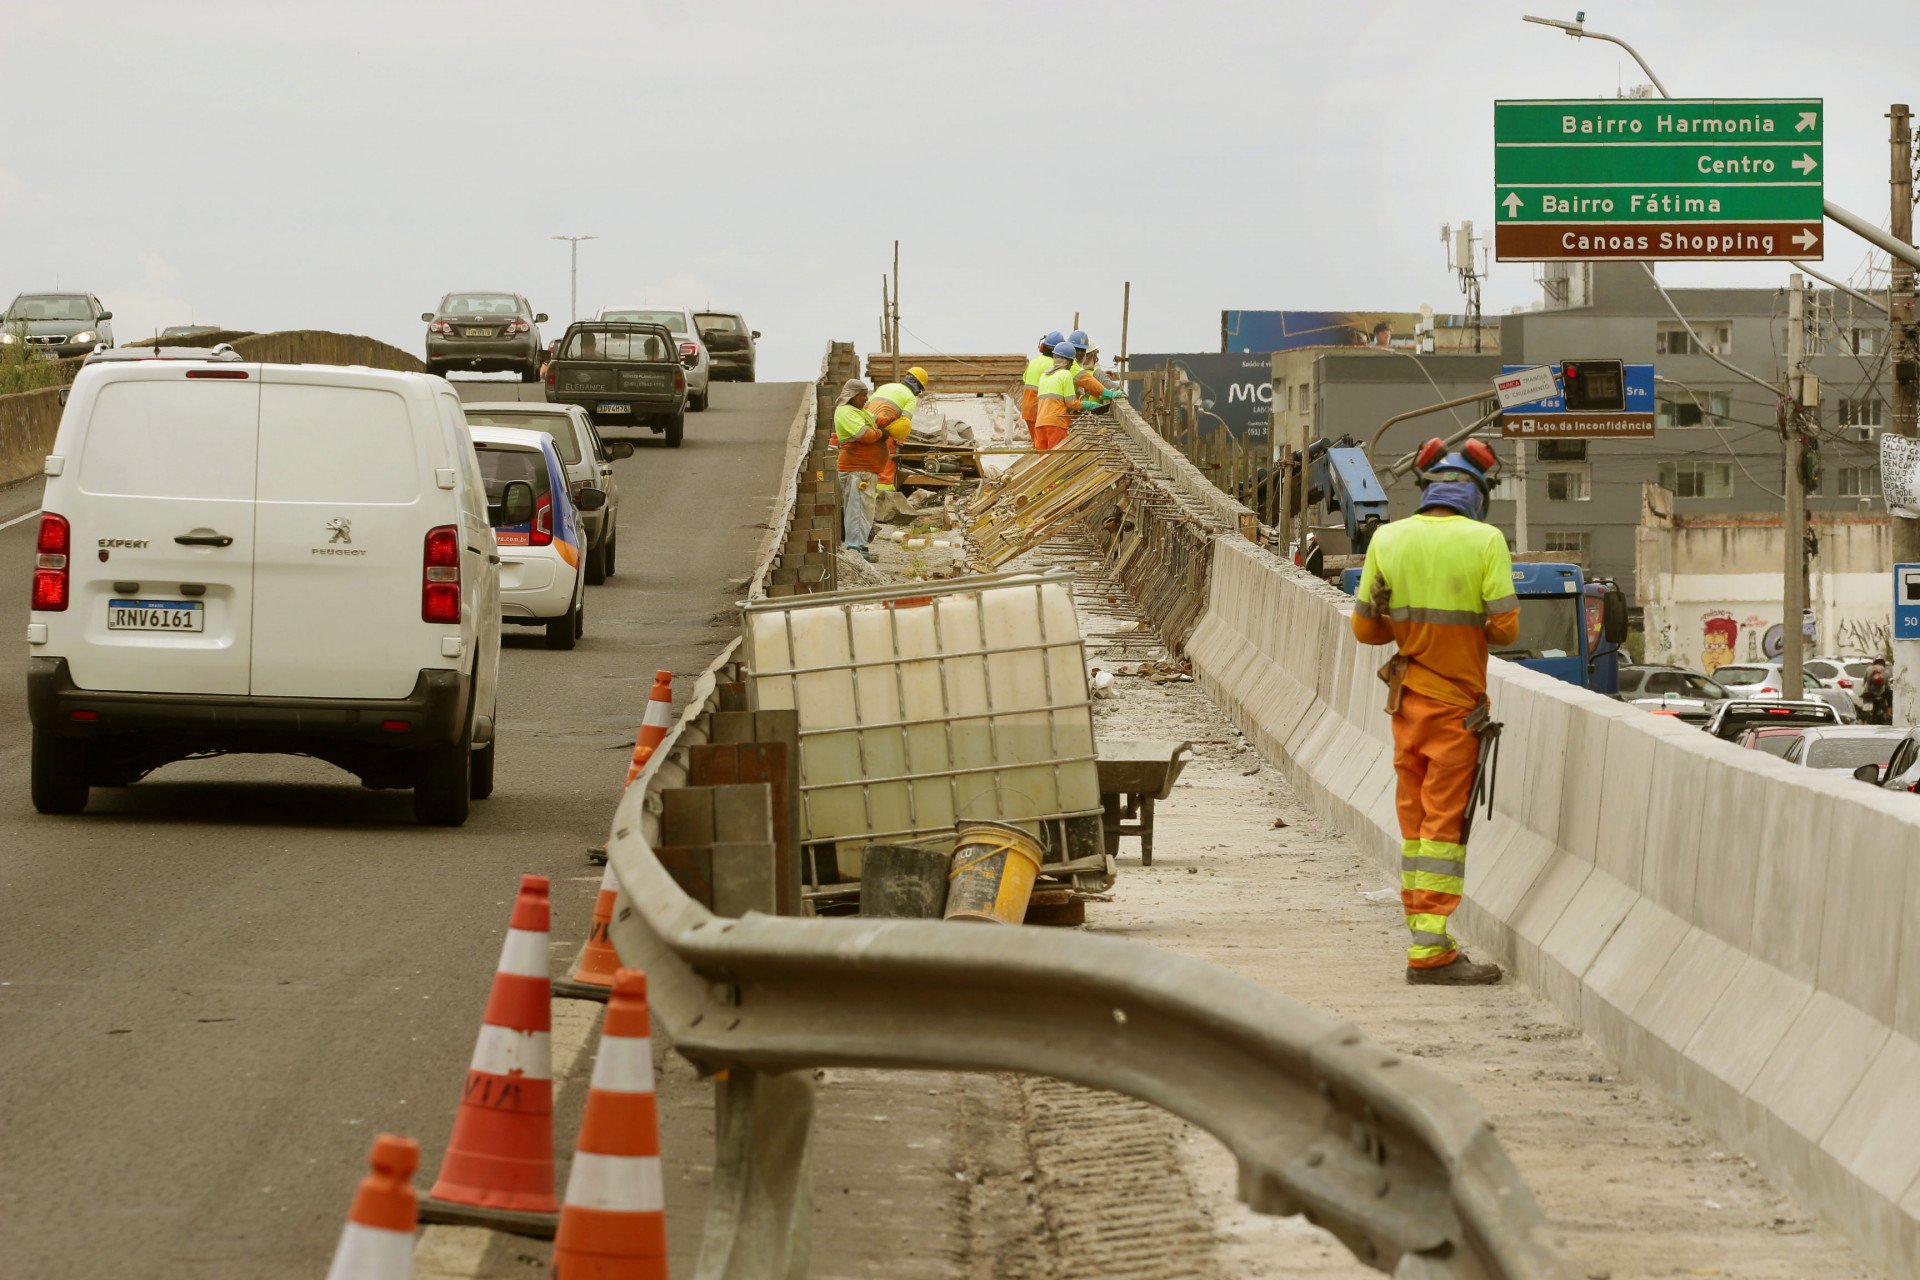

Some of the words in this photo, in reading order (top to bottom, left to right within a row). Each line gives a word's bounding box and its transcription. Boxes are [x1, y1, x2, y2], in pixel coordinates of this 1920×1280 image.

[1562, 115, 1643, 133] Bairro
[1657, 114, 1775, 133] Harmonia
[1697, 155, 1775, 173] Centro
[1542, 195, 1614, 213] Bairro
[1631, 193, 1721, 213] Fátima
[1562, 232, 1649, 250] Canoas
[1659, 232, 1774, 253] Shopping
[1499, 380, 1520, 390] NUNCA
[1626, 387, 1647, 396] Sra.
[1541, 399, 1560, 408] das
[1559, 420, 1572, 431] da
[1575, 420, 1652, 431] Inconfidência
[1883, 450, 1904, 462] DEUS
[98, 538, 150, 549] EXPERT
[311, 547, 367, 556] PEUGEOT
[116, 609, 193, 628] RNV6I61
[1904, 616, 1918, 626] 50
[465, 1075, 522, 1112] VIA
